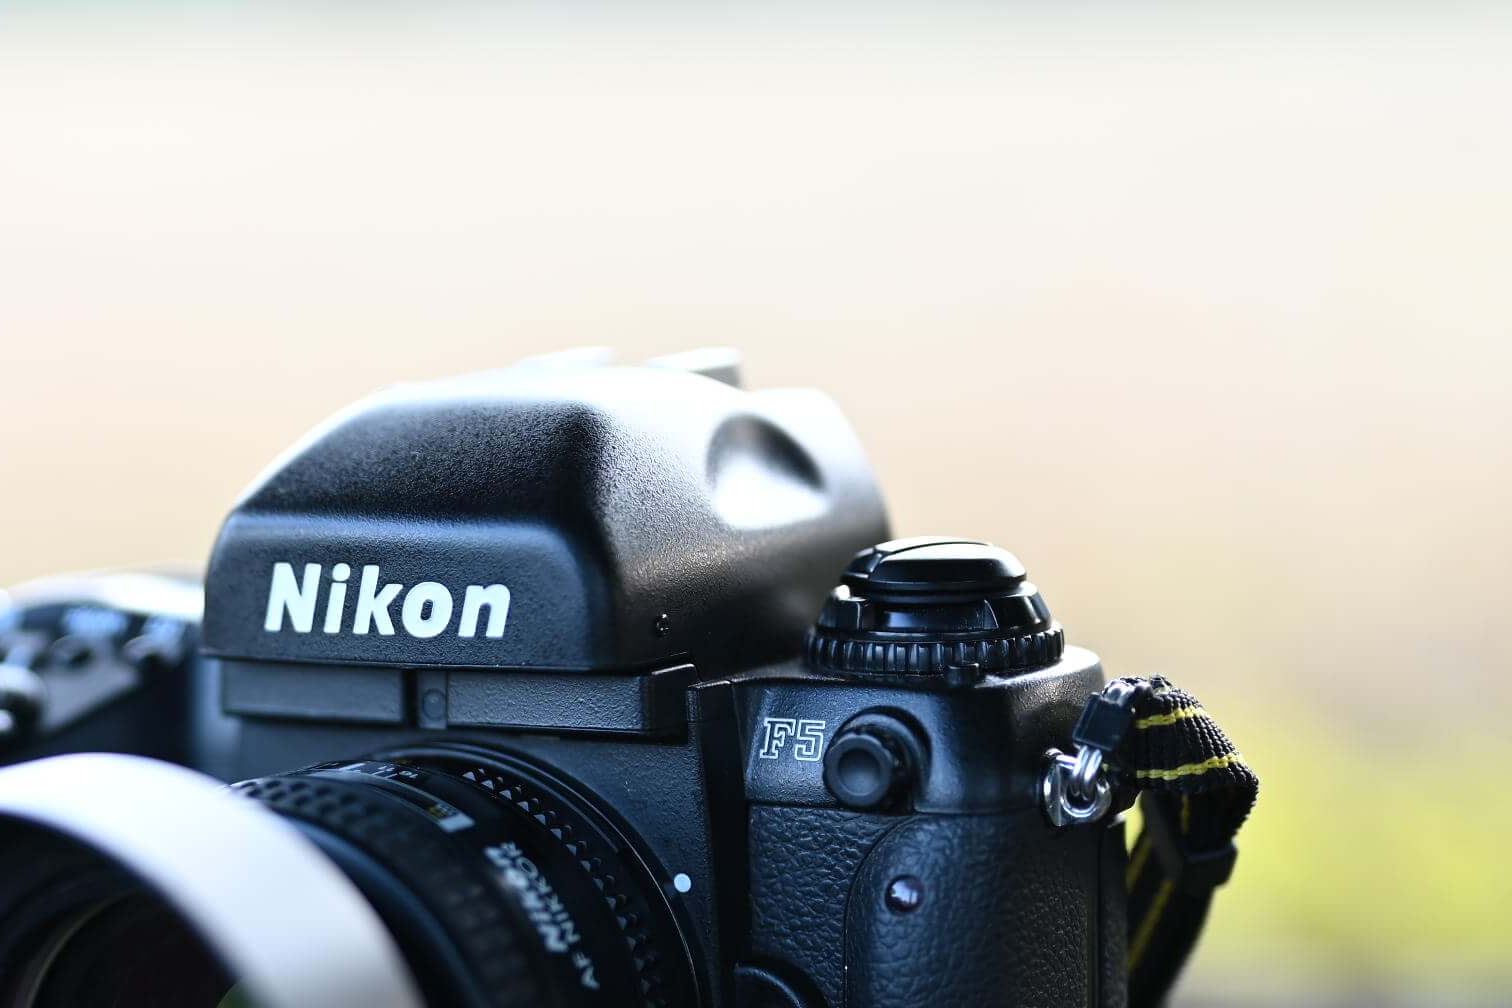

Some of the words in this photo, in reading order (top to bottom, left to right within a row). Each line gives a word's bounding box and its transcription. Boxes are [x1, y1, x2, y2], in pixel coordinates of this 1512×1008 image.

[264, 562, 511, 638] Nikon
[759, 717, 826, 761] F5
[499, 839, 582, 945] NIKKOR
[573, 951, 601, 990] AF
